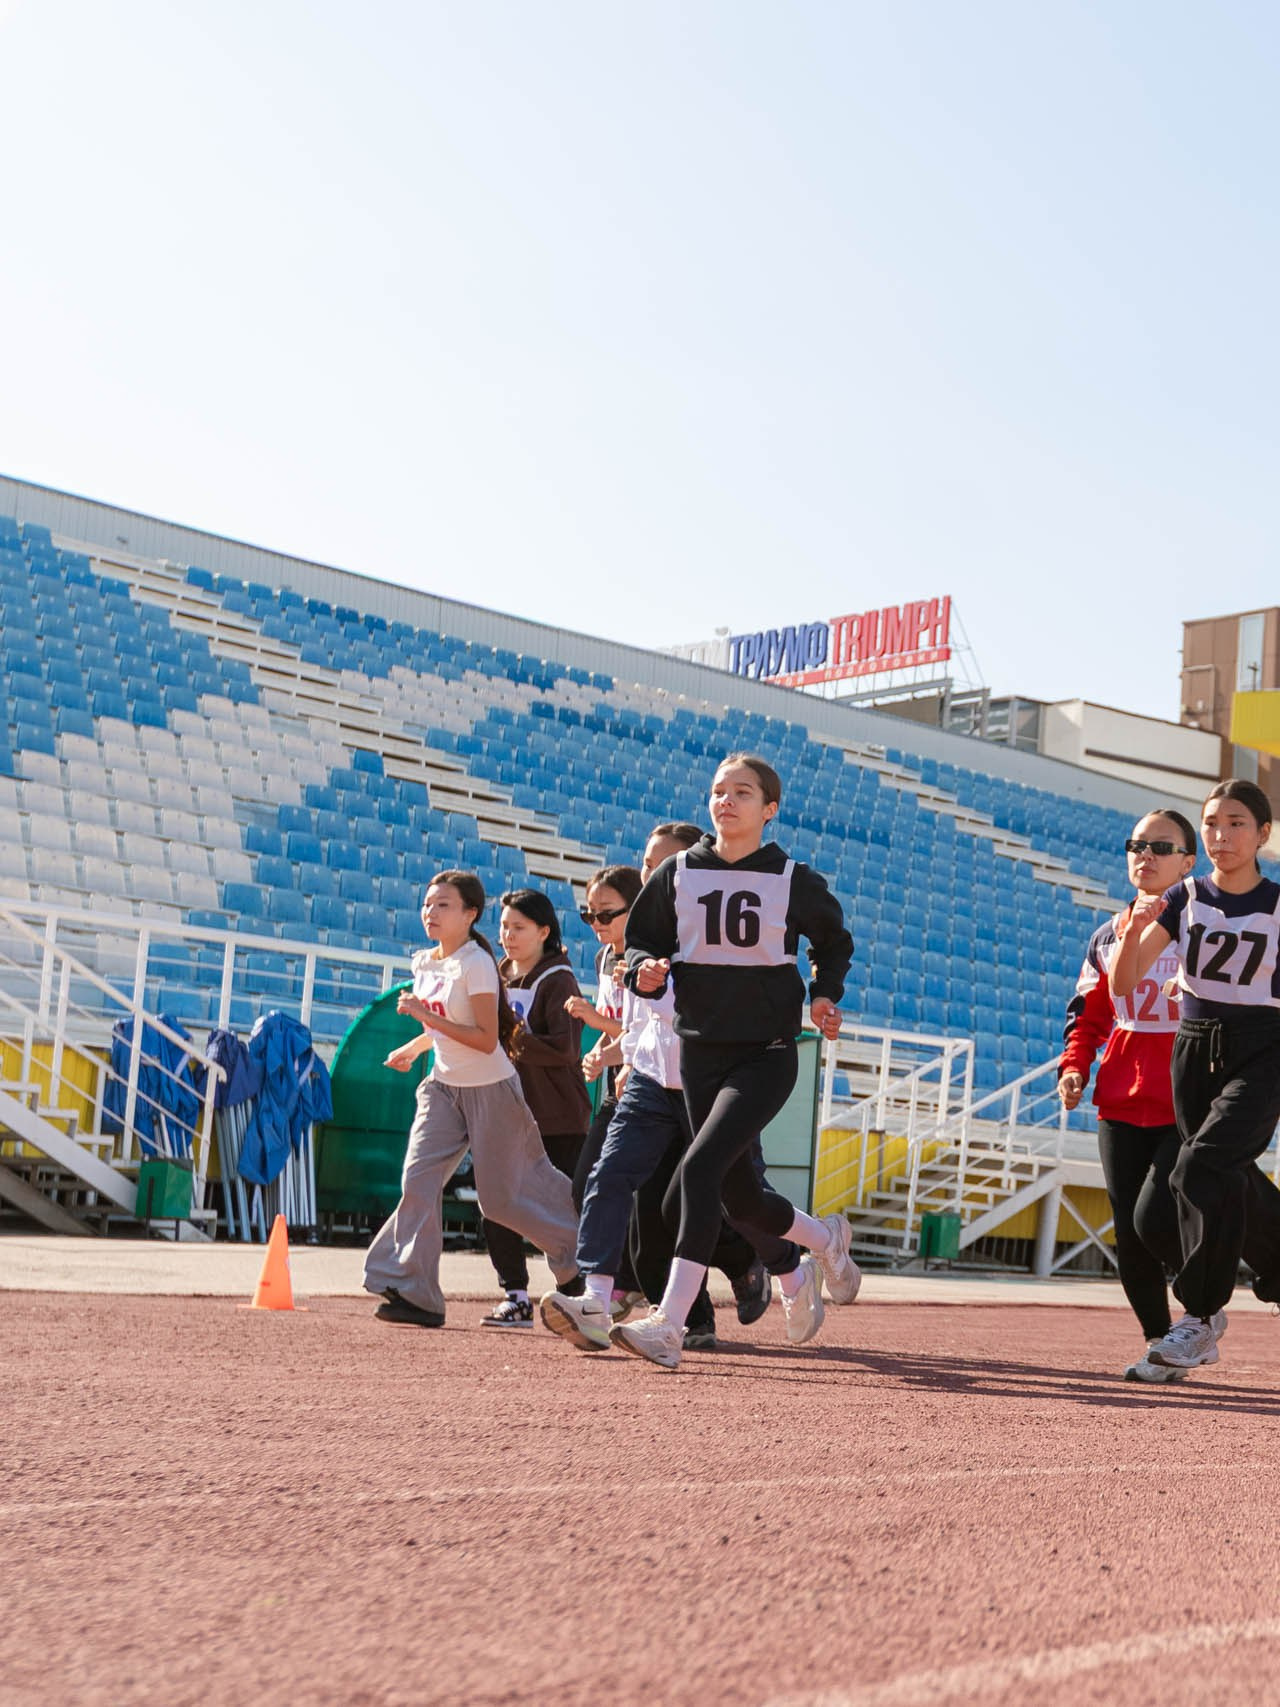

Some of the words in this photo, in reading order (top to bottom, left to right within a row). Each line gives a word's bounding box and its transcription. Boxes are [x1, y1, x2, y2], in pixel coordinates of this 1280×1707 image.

[729, 621, 829, 680] ТРИУМФ
[829, 595, 951, 665] TRIUMPH
[697, 890, 761, 947] 16
[1187, 924, 1268, 986] 127
